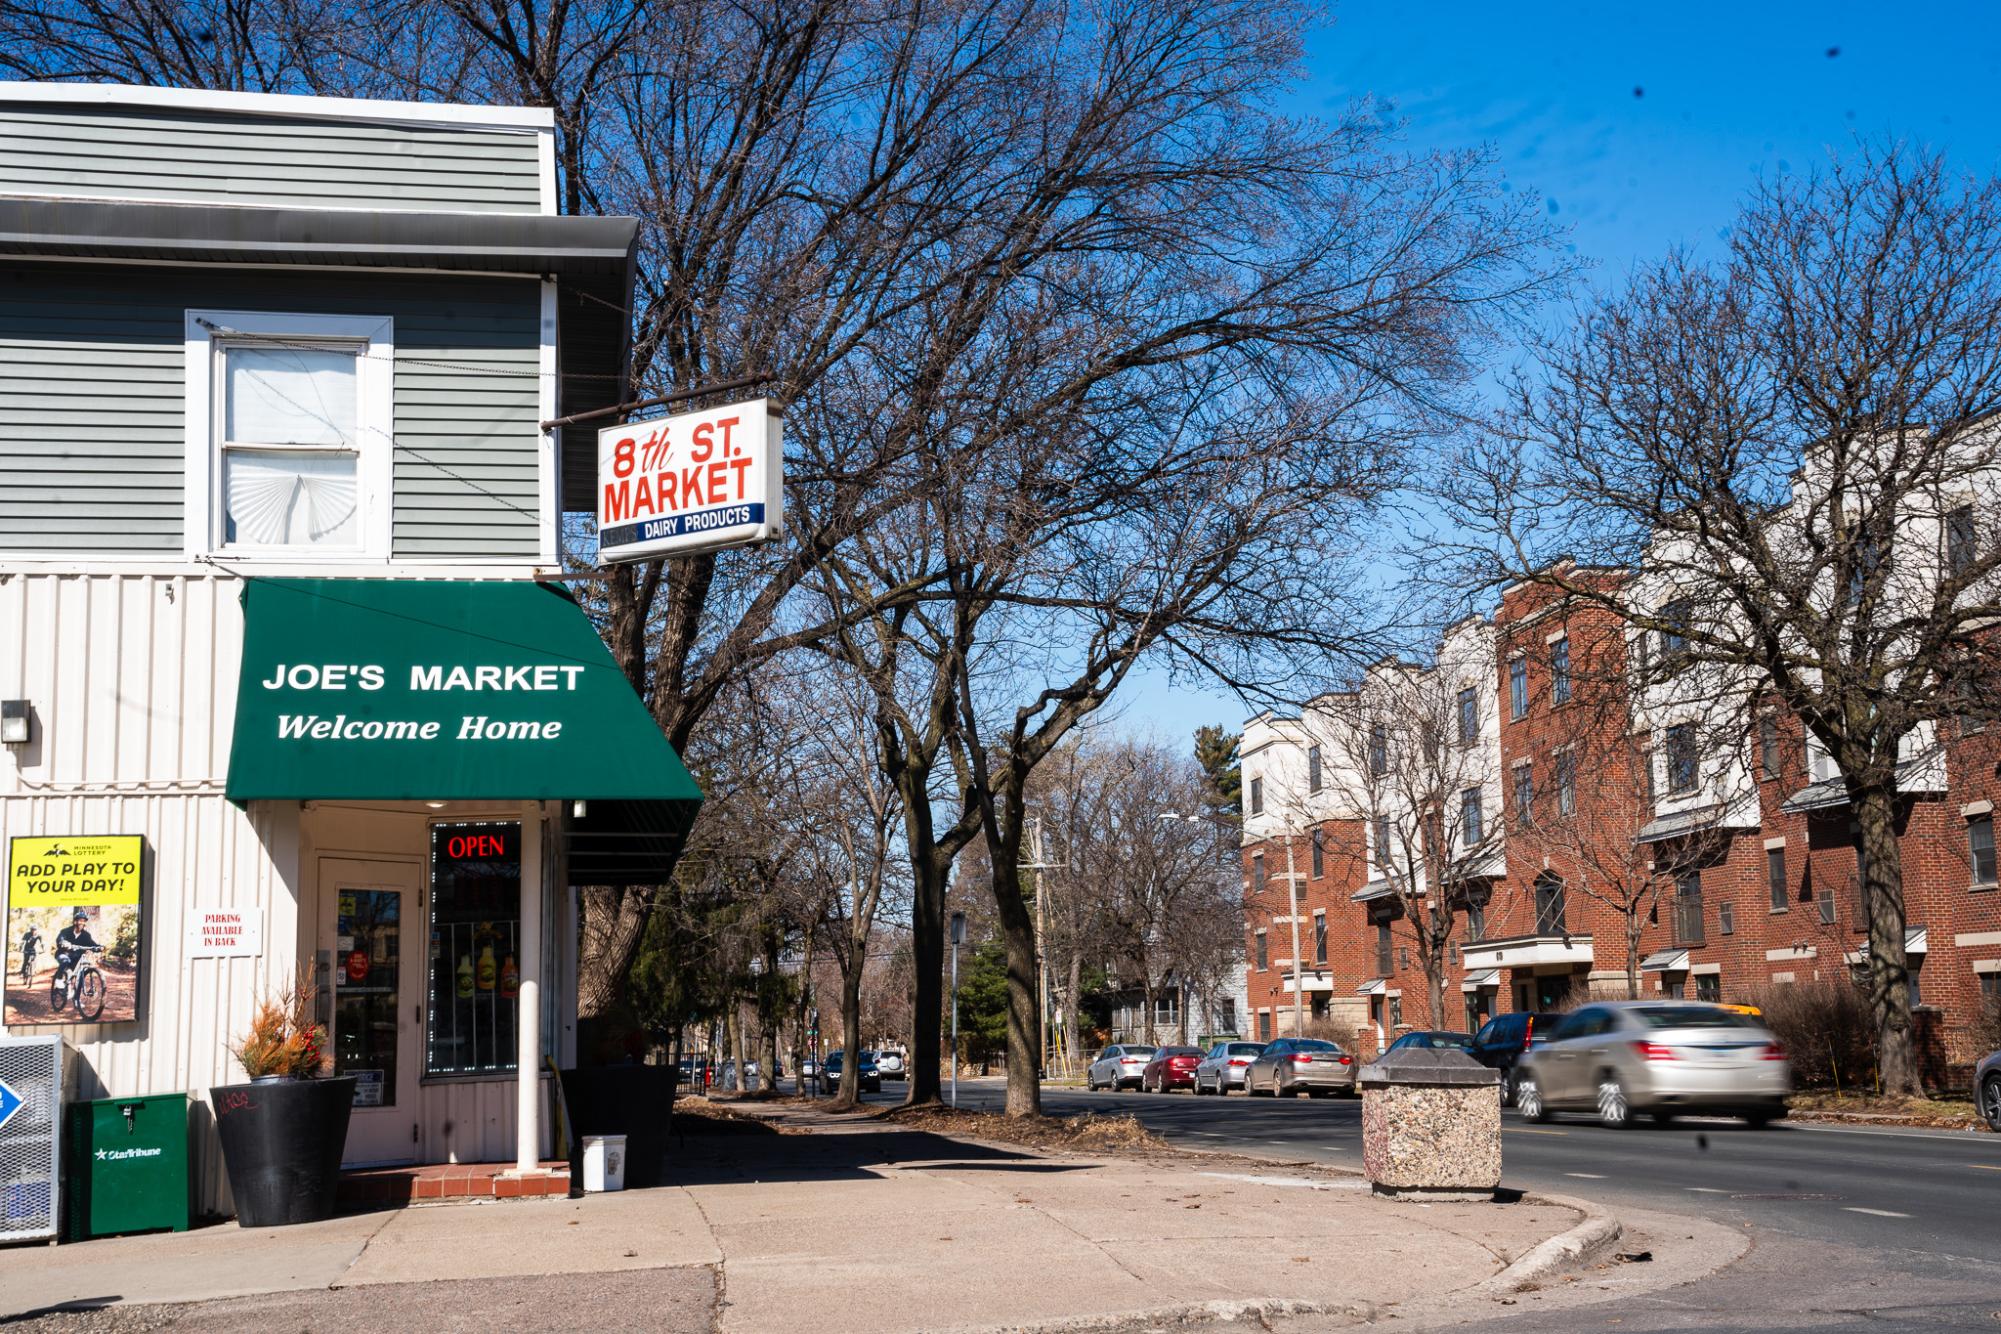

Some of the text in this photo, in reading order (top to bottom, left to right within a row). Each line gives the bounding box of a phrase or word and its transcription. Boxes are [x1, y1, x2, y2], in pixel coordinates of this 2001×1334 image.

[613, 416, 742, 479] 8th ST.
[604, 457, 753, 524] MARKET
[645, 518, 678, 539] DAIRY
[685, 507, 750, 532] PRODUCTS
[263, 664, 585, 691] JOE'S MARKET
[277, 714, 563, 740] Welcome Home
[448, 835, 504, 858] OPEN
[17, 862, 135, 877] ADD PLAY TO
[27, 879, 125, 894] YOUR DAY!
[205, 914, 241, 923] PARKING
[202, 926, 243, 935] AVAILABLE
[204, 938, 236, 946] IN BACK
